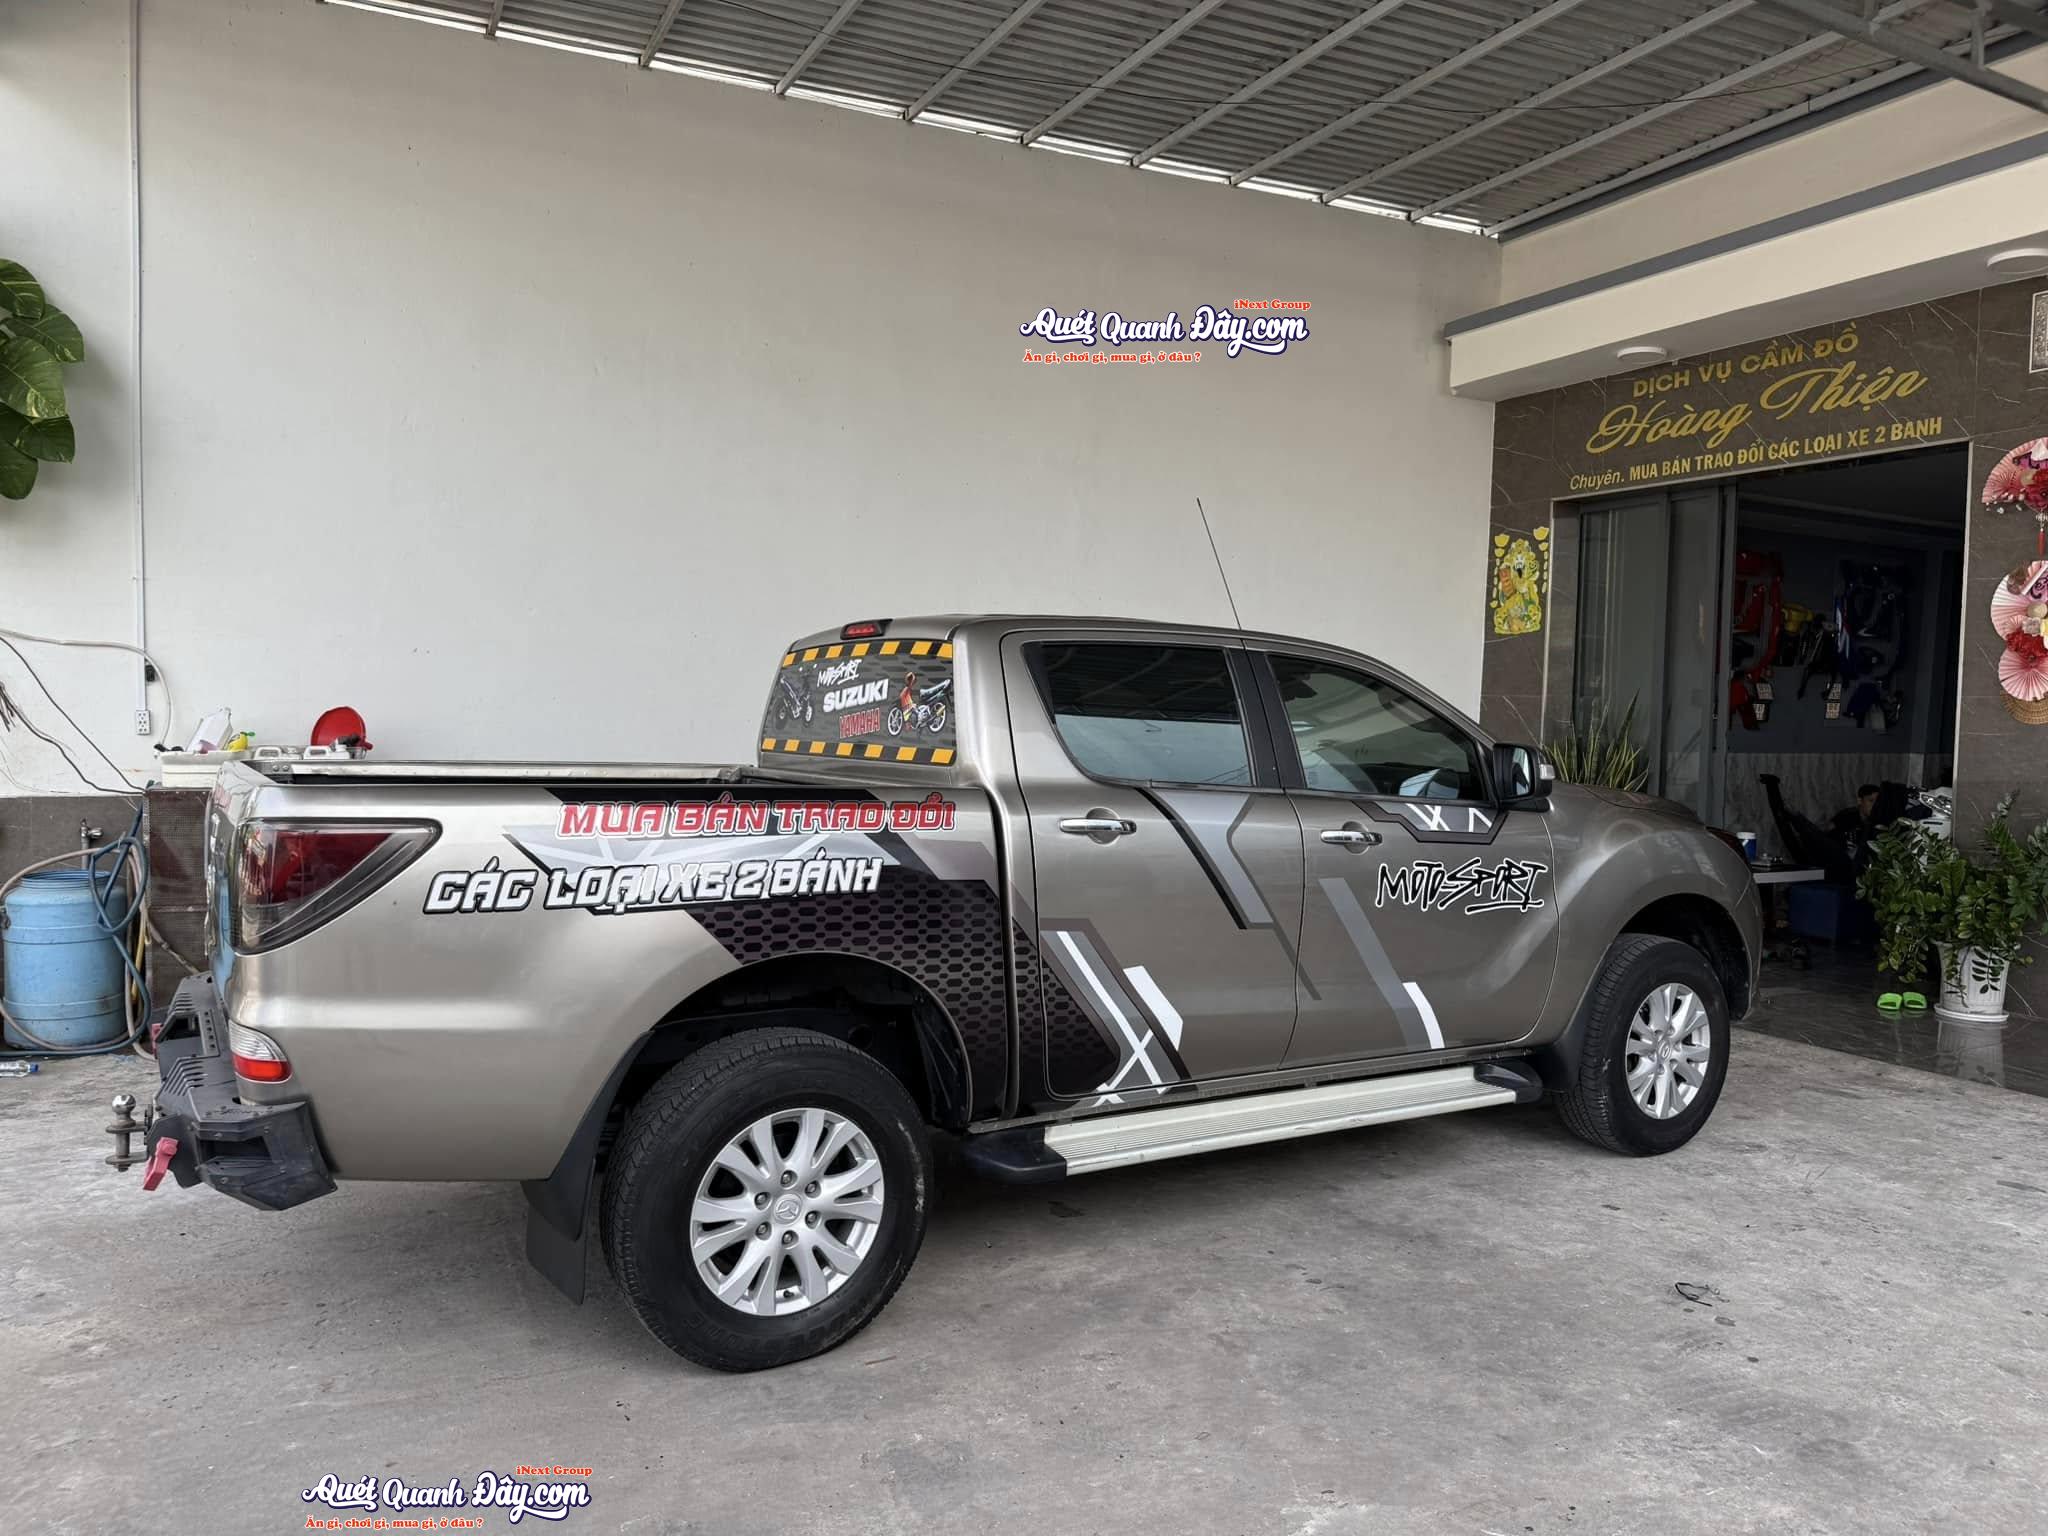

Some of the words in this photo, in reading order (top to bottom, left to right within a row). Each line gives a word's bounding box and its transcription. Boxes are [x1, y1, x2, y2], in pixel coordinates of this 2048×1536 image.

[1633, 370, 1690, 398] DỊCH
[1699, 360, 1732, 384] VỤ
[1740, 339, 1803, 374] CẦM
[1813, 322, 1858, 359] ĐỒ
[1586, 400, 1753, 454] Hoàng
[1760, 360, 1928, 420] Thiện
[1629, 466, 1658, 481] MUA
[1662, 455, 1691, 476] BÁN
[1695, 451, 1734, 471] TRAO
[1768, 436, 1800, 460] CÁC
[1804, 432, 1842, 455] LOẠI
[1847, 428, 1869, 447] XE
[1874, 426, 1886, 444] 2
[822, 679, 889, 713] SUZUKI
[839, 707, 881, 739] YAMAHA
[556, 801, 669, 839] MUA
[773, 801, 888, 834] TRAO
[543, 864, 660, 915] LOẠI
[659, 860, 732, 902] XE
[731, 858, 770, 900] 2
[769, 846, 883, 897] BÁNH
